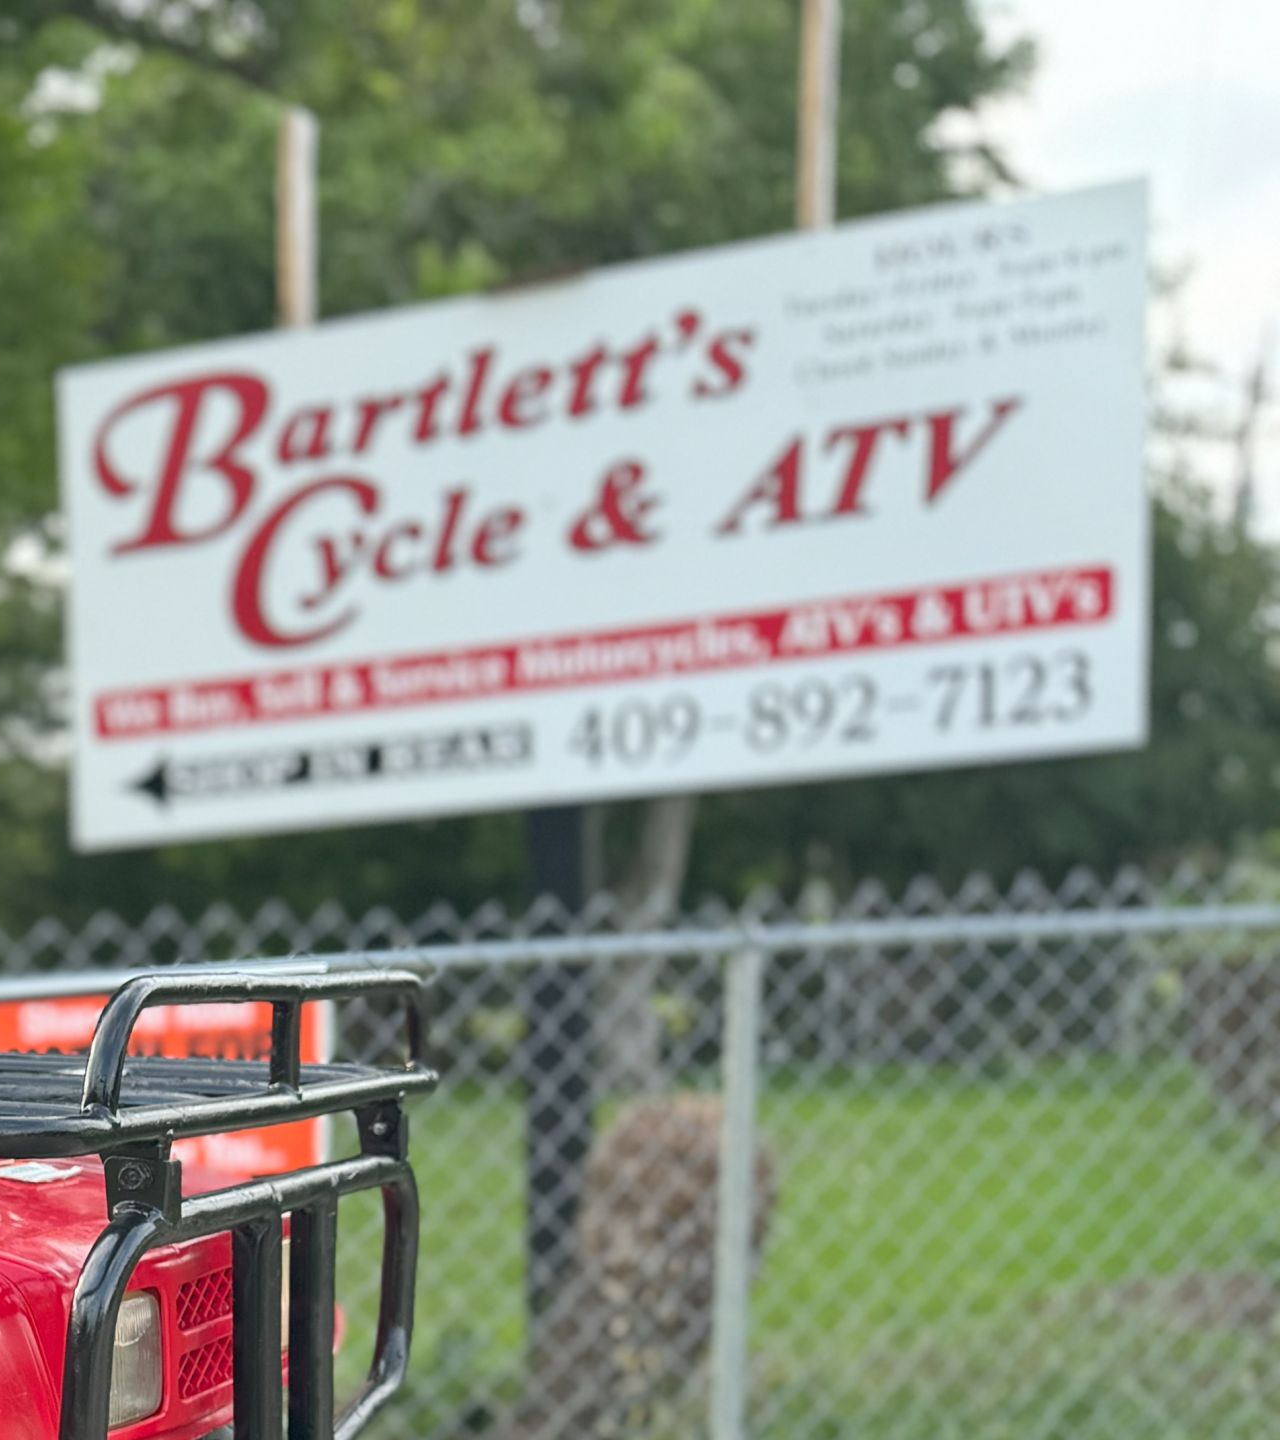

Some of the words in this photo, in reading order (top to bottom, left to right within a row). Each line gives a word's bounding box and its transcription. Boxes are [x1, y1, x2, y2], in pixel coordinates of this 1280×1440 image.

[92, 308, 757, 559] Bartlett's
[228, 474, 525, 652] Cycle
[565, 456, 662, 555] &
[713, 396, 1024, 538] ATV
[778, 599, 902, 655] ATV's
[910, 594, 954, 639] &
[963, 573, 1106, 632] UTV's
[566, 648, 1095, 768] 409-892-7123
